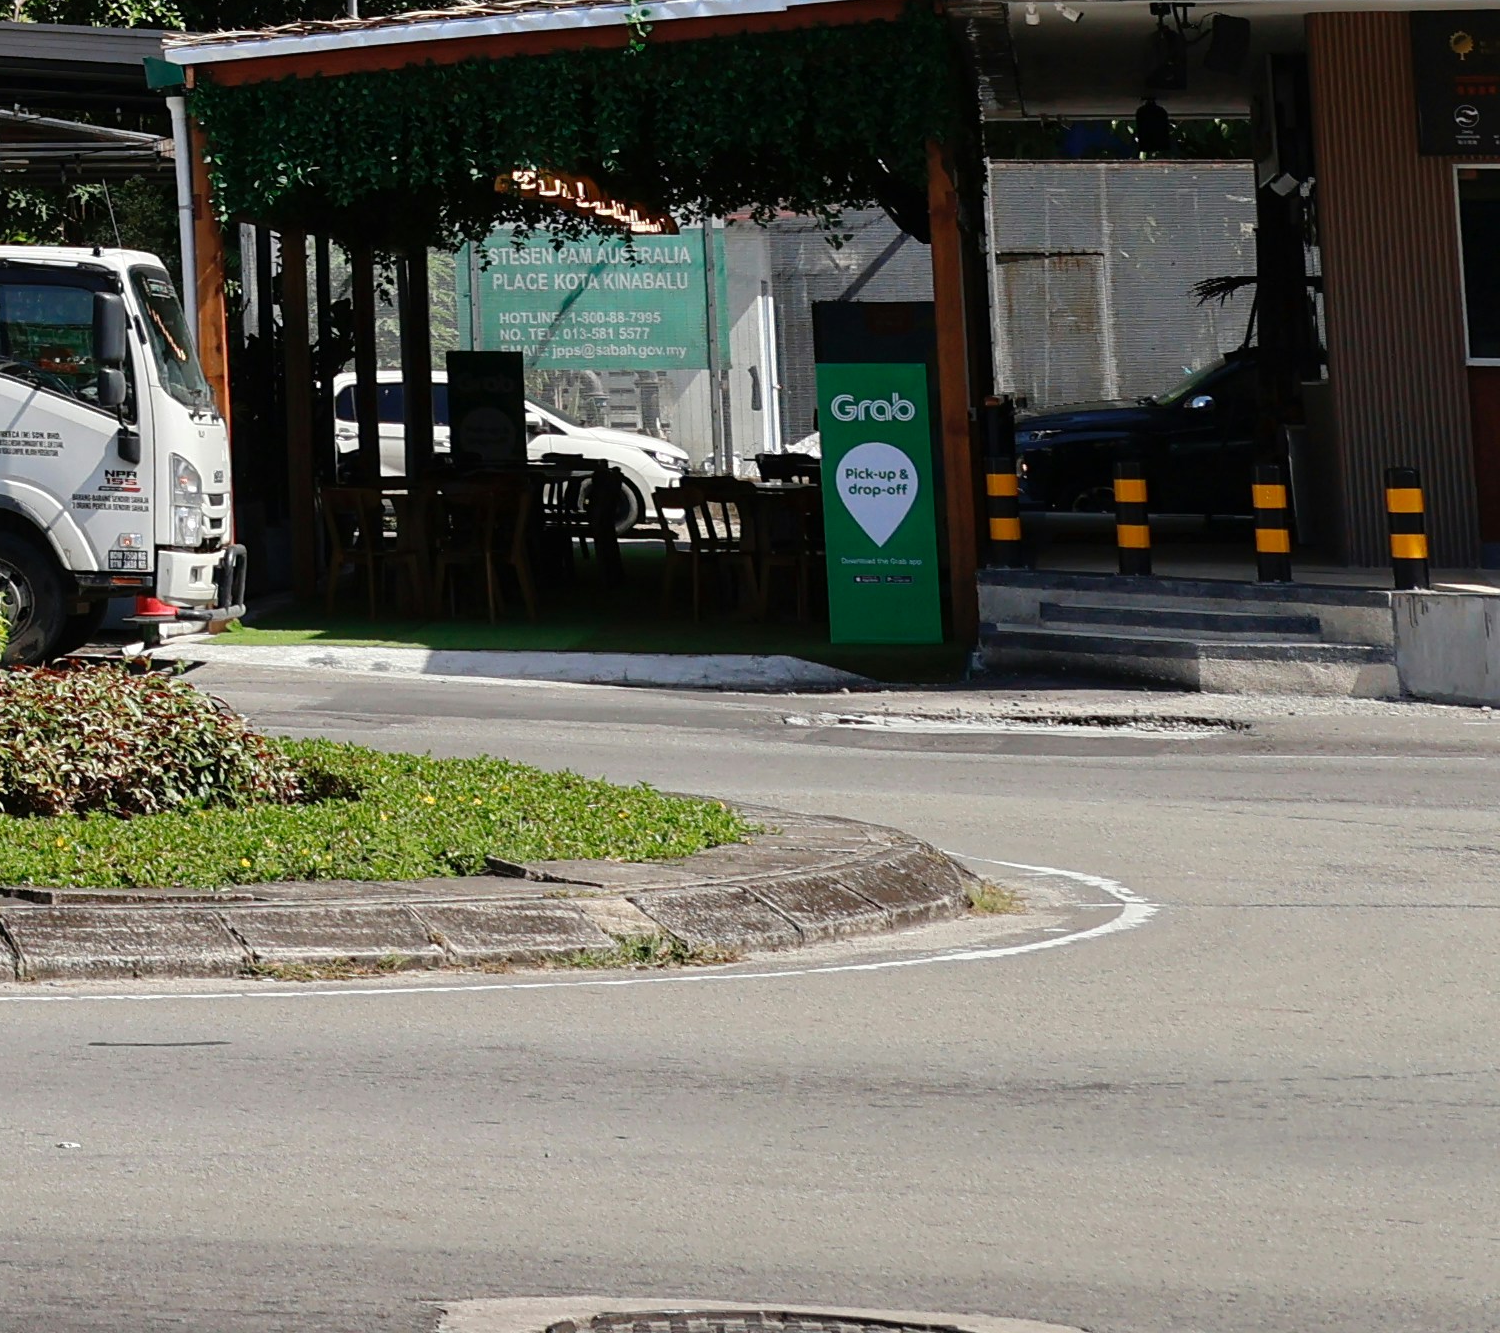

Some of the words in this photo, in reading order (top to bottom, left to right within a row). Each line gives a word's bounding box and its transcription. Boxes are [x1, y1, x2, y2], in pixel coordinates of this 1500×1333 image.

[488, 247, 553, 265] STESEN
[558, 247, 592, 264] PAM
[492, 273, 549, 290] PLACE
[554, 273, 599, 290] KOTA
[603, 272, 688, 290] KINABALU
[500, 328, 525, 341] NO.
[619, 327, 650, 340] 5577
[552, 343, 687, 359] jpps@sabah.gov.my
[830, 392, 916, 422] Grab
[104, 469, 137, 478] NPR
[845, 468, 896, 482] Pick-up
[899, 468, 909, 480] &
[848, 483, 908, 498] drop-off
